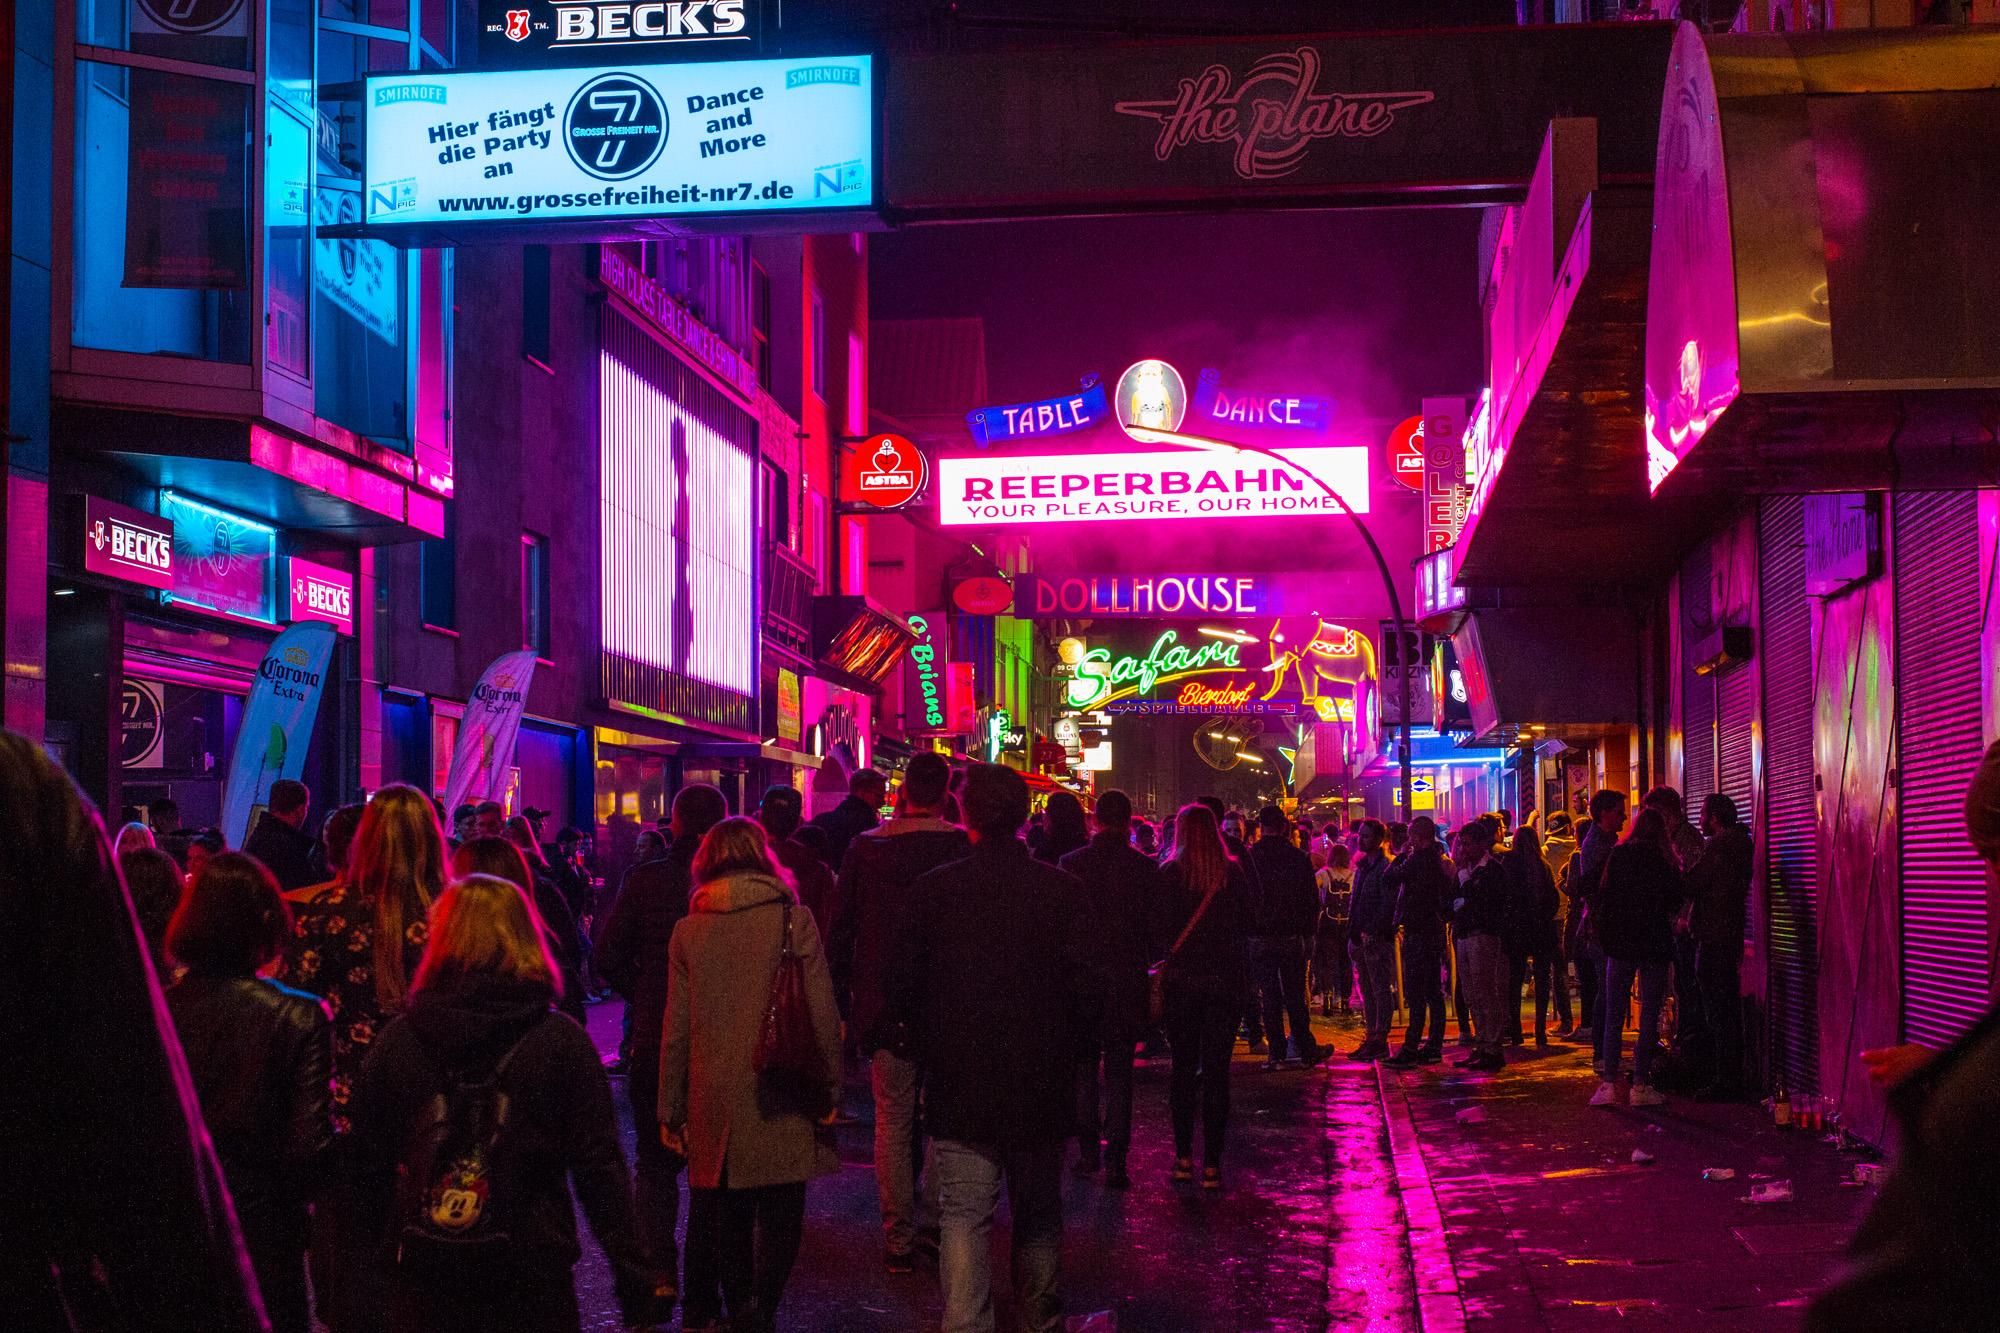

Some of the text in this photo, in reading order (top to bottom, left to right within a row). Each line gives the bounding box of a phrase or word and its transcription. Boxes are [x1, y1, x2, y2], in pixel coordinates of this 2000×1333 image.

[533, 22, 549, 30] TM.
[556, 0, 745, 40] BECK'S
[687, 86, 764, 113] Dance
[1234, 46, 1393, 179] plane
[428, 102, 556, 144] Hier fängt
[589, 89, 642, 168] 7
[644, 125, 660, 134] NR.
[706, 108, 753, 133] and
[438, 129, 551, 165] die Party
[700, 133, 766, 158] More
[484, 161, 513, 179] an
[439, 181, 794, 214] www.grossefreiheit-nr7.de
[601, 243, 625, 291] HIGH
[627, 267, 655, 317] CLASS
[1003, 398, 1090, 436] TABLE
[1212, 392, 1301, 425] DANCE
[865, 475, 909, 486] ASTRA
[964, 468, 1304, 500] REEPERBAHN
[967, 504, 1036, 519] YOUR
[1046, 499, 1190, 515] PLEASURE,
[1198, 499, 1251, 511] OUR
[111, 525, 170, 568] BECK'S
[308, 581, 350, 616] BECK'S
[1036, 577, 1257, 613] DOLLHOUSE
[260, 656, 320, 689] Corona
[1067, 629, 1247, 708] Safari
[273, 681, 305, 702] Extra
[1178, 680, 1256, 710] Bierdorf
[1003, 731, 1024, 746] sky
